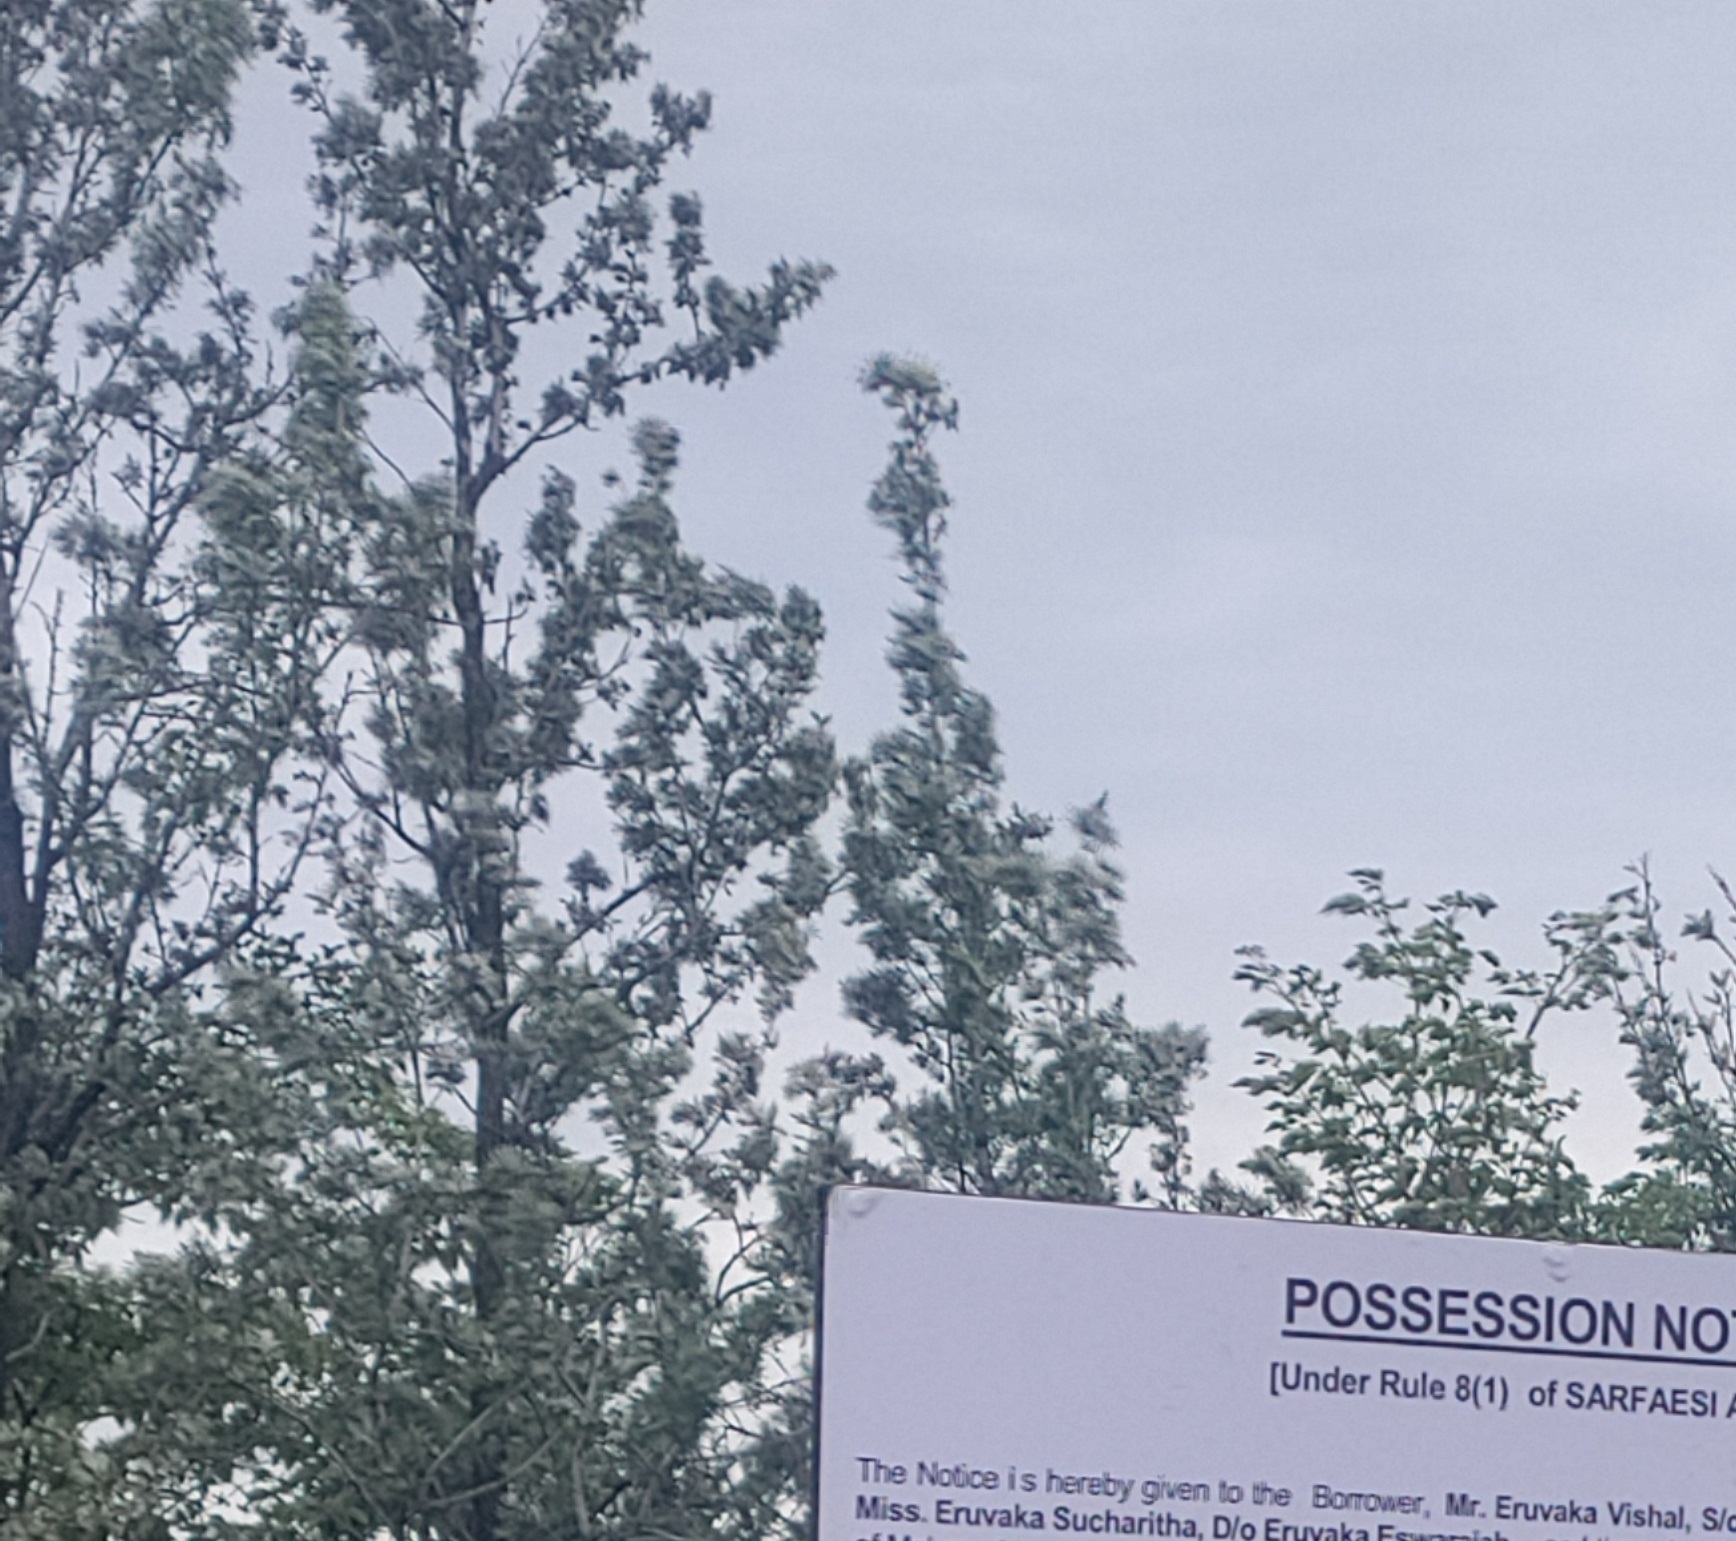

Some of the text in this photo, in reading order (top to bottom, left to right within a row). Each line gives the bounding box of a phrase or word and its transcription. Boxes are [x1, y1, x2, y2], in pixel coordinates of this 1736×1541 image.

[1284, 1276, 1637, 1350] POSSESSION
[1379, 1368, 1447, 1402] Rule
[1454, 1373, 1511, 1413] 8(1)
[1527, 1378, 1561, 1410] of
[1564, 1380, 1719, 1420] SARFAESI
[855, 1494, 929, 1524] Miss.
[934, 1498, 1047, 1532] Eruvaka
[916, 1460, 1001, 1492] Notice
[1045, 1467, 1137, 1505] hereby
[1140, 1474, 1212, 1507] given
[1494, 1494, 1600, 1526] Eruvaka
[1606, 1500, 1694, 1536] Vishal,
